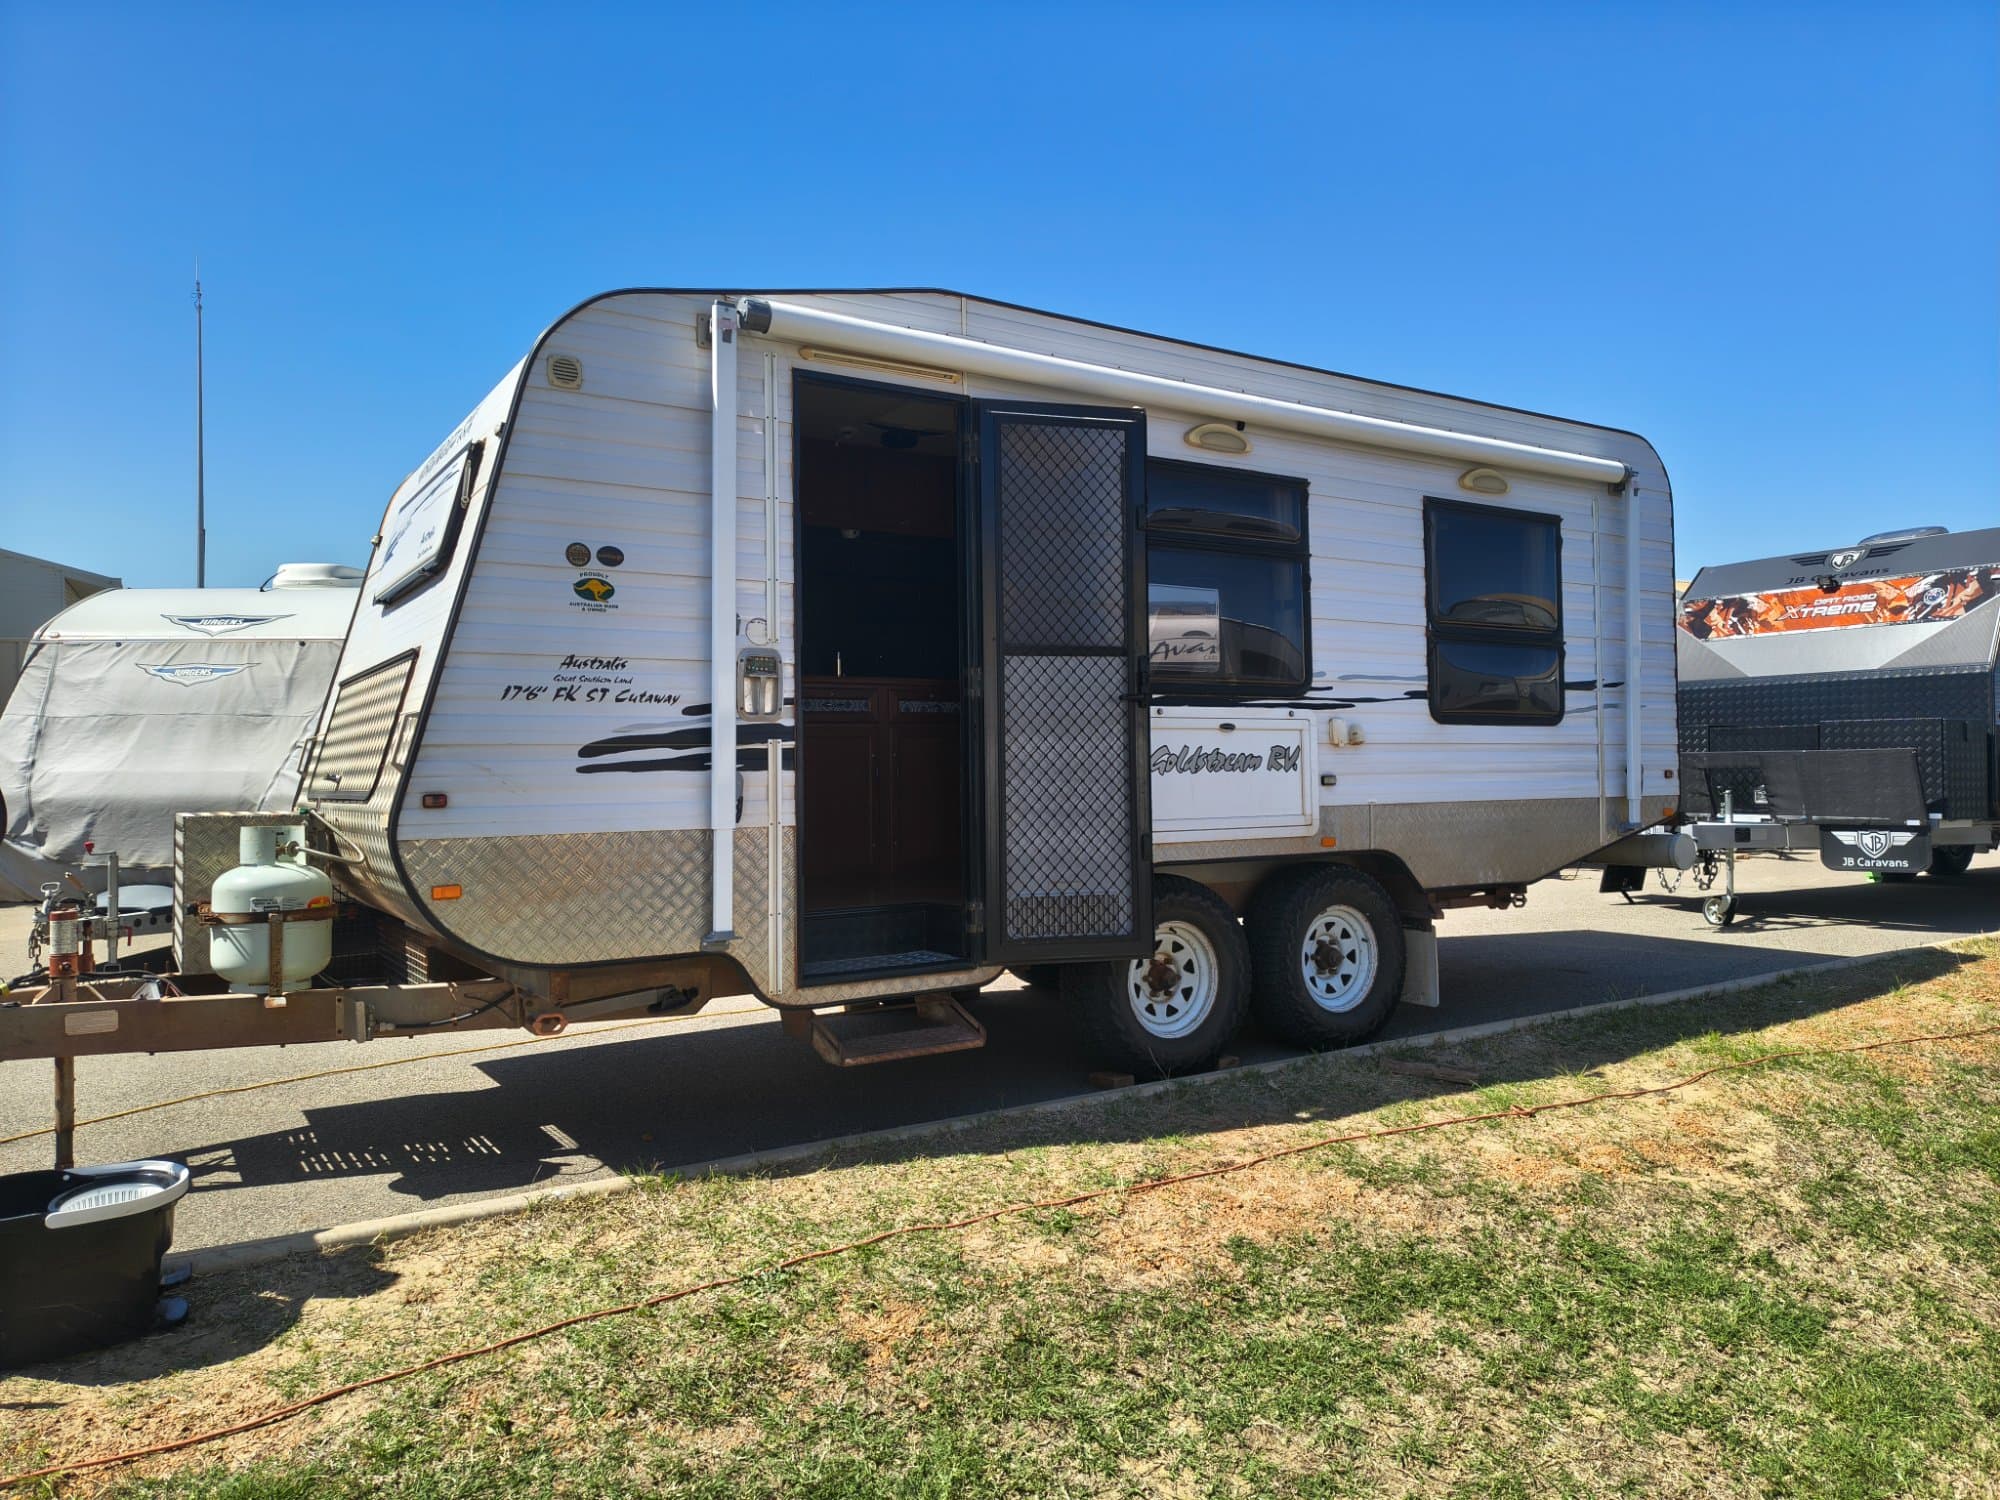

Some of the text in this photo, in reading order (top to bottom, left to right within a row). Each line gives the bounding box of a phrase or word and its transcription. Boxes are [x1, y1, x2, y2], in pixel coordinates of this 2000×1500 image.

[1785, 576, 1805, 585] JB
[1814, 593, 1877, 606] DIRT ROAD
[200, 618, 245, 626] JURGENS
[559, 654, 629, 671] Australis
[174, 668, 213, 677] JURGENS
[579, 674, 612, 684] Southern
[614, 676, 633, 685] Land
[551, 684, 582, 703] FK
[585, 687, 610, 703] ST
[614, 688, 681, 706] Cutaway
[1150, 744, 1263, 776] Goldstream
[1842, 857, 1909, 868] JB Caravans
